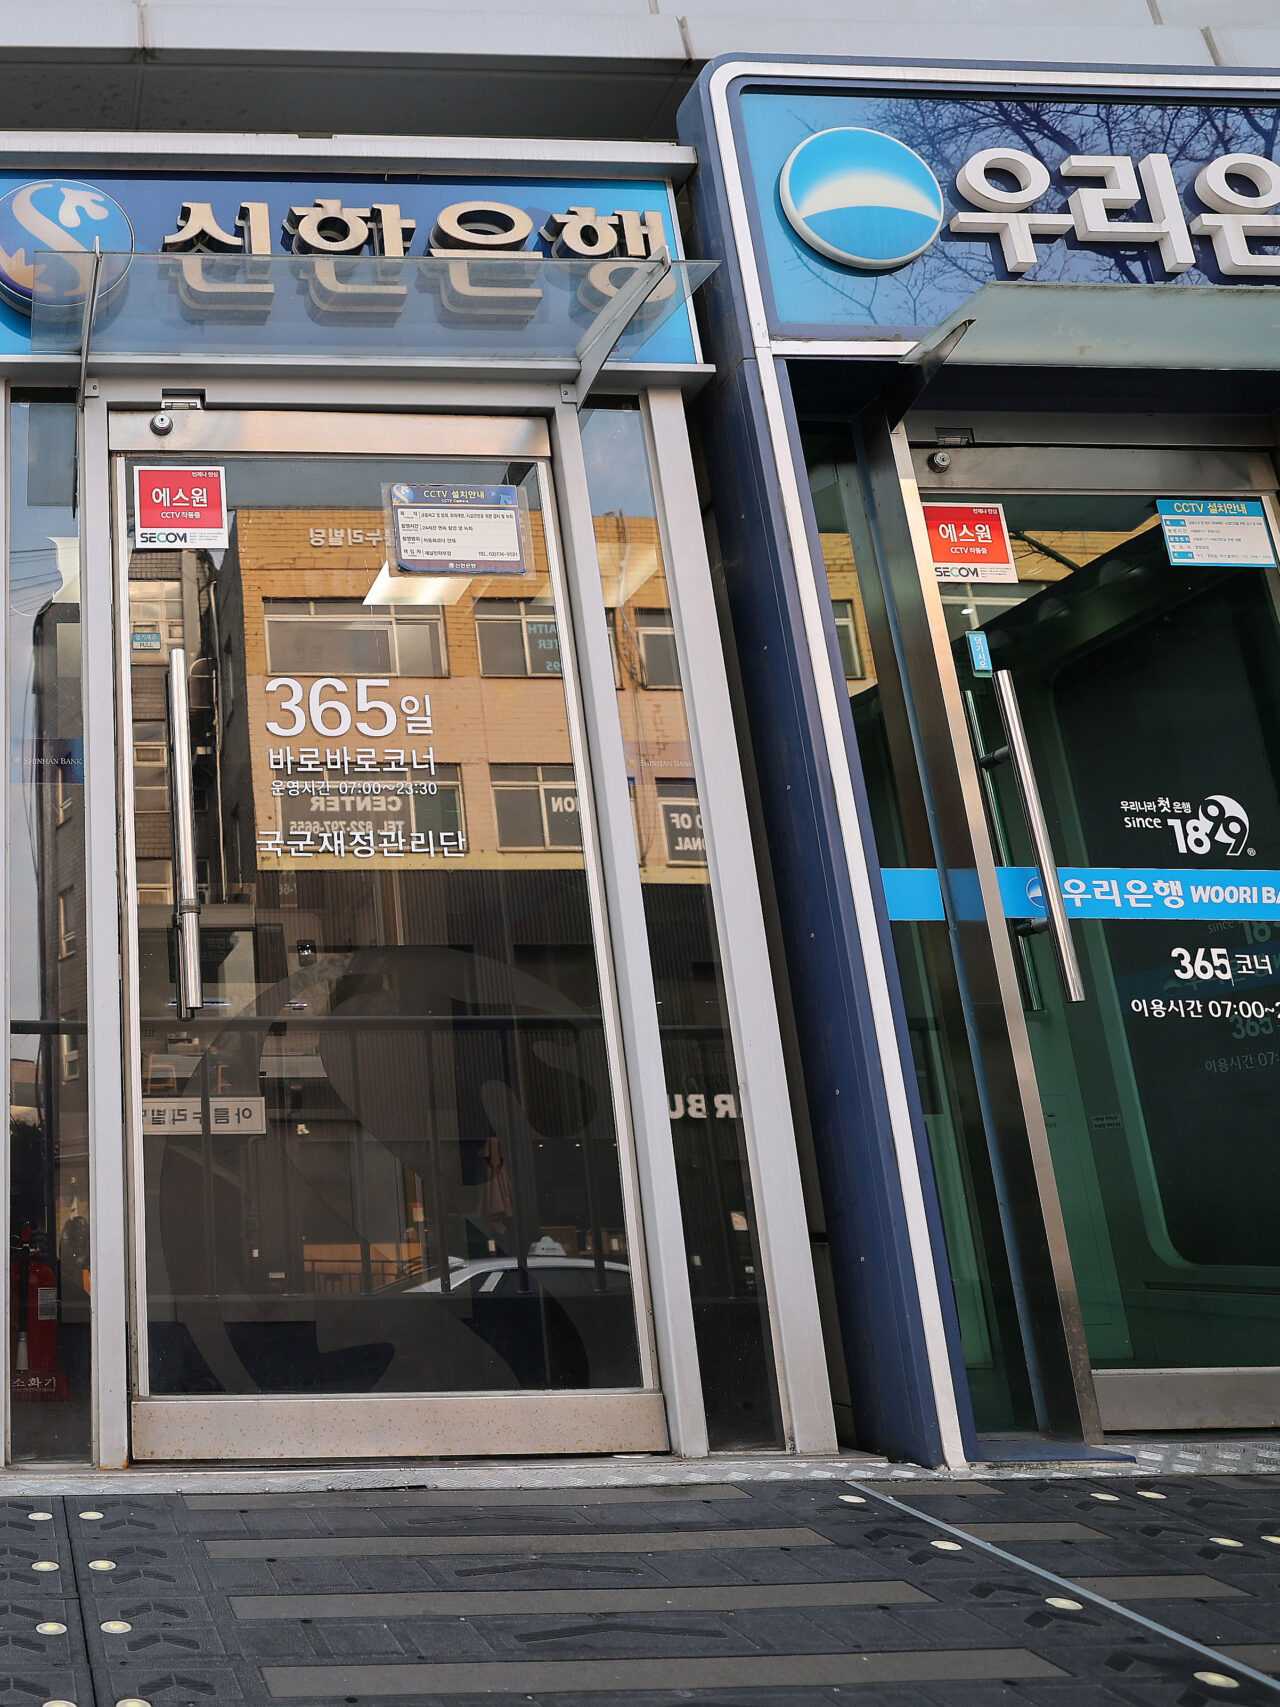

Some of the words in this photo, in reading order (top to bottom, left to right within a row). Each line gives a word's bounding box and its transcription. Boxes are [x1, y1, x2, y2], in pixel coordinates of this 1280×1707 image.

[162, 198, 677, 314] 신한은행
[151, 487, 208, 507] 에스원
[423, 490, 448, 498] CCTV
[451, 490, 485, 499] 설치안내
[160, 511, 180, 519] CCTV
[1173, 502, 1204, 513] CCTV
[1207, 502, 1248, 514] 설치안내
[140, 532, 187, 543] SECOM
[938, 523, 992, 543] 에스원
[950, 546, 968, 554] CCTV
[934, 566, 979, 578] SECOM
[268, 746, 436, 776] 바로바로코너
[270, 780, 331, 796] 운영시간
[338, 781, 438, 795] 07:00~23:30
[1120, 800, 1157, 813] 우리나라
[1157, 797, 1171, 813] 첫
[1172, 801, 1192, 814] 은행
[256, 830, 467, 858] 국군재정관리단
[1062, 878, 1185, 909] 우리은행
[1190, 885, 1258, 904] WOORI
[1171, 947, 1233, 980] 365
[1234, 954, 1273, 975] 코너
[1131, 999, 1203, 1018] 이용시간
